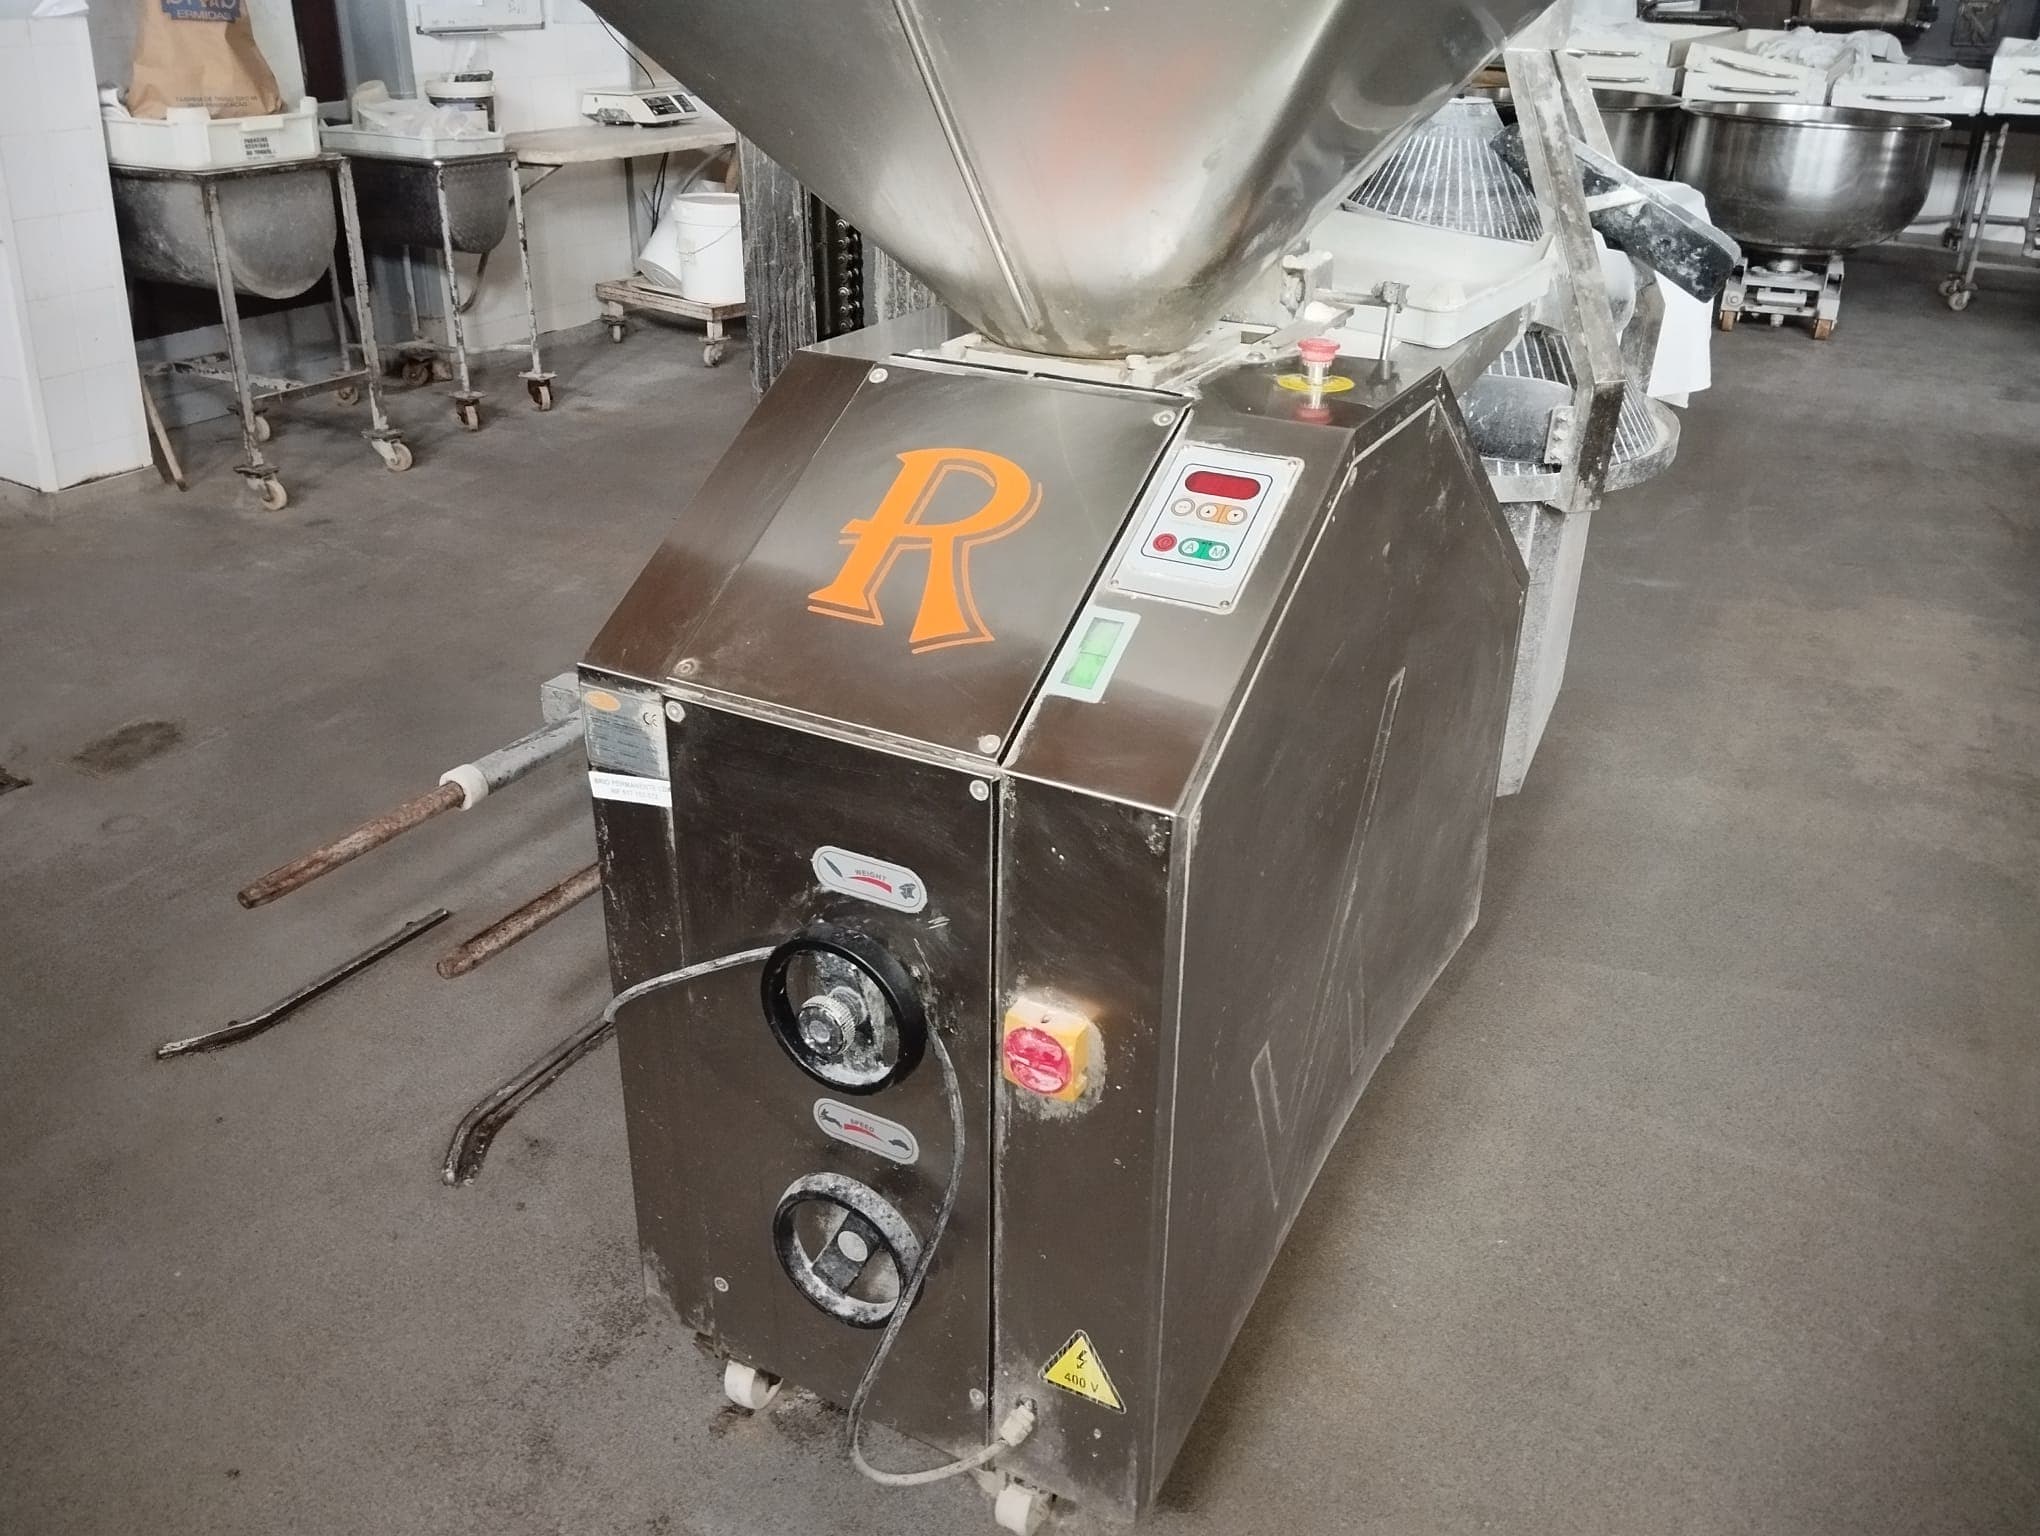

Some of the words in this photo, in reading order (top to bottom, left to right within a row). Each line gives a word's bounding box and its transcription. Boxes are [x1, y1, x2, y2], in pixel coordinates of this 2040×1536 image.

[806, 446, 1043, 654] R
[1185, 543, 1194, 552] A
[1212, 547, 1225, 557] M
[854, 869, 887, 881] WEIGHT
[850, 1118, 875, 1132] SPEED
[1064, 1372, 1086, 1389] 400
[1090, 1381, 1099, 1393] V
